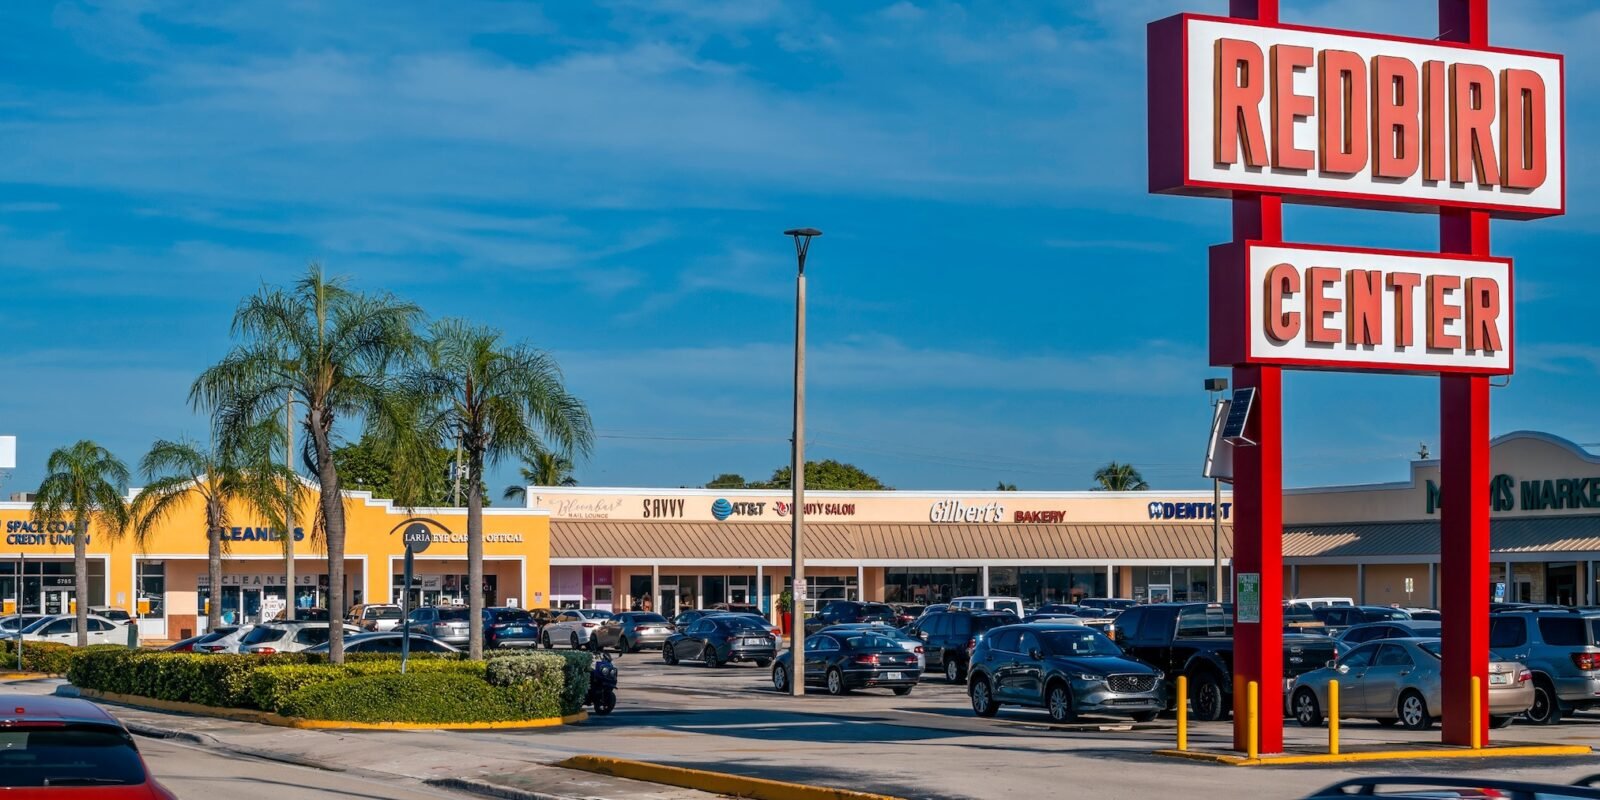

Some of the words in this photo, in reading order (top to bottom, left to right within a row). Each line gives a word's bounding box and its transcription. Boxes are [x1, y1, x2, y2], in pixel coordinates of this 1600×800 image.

[1213, 37, 1548, 190] REDBIRD
[1264, 262, 1504, 353] CENTER
[643, 498, 685, 518] SAVVY
[730, 501, 767, 516] AT&T
[825, 503, 856, 516] SALON
[929, 498, 1005, 523] Gilbert's
[1013, 510, 1067, 523] BAKERY
[7, 520, 45, 533] SPACE
[47, 520, 89, 533] COAT
[6, 533, 46, 545] CREDIT
[206, 526, 305, 542] LEANES
[432, 534, 449, 543] EYE
[450, 534, 470, 543] CAR
[486, 534, 524, 543] OPTICAL
[221, 575, 311, 585] CLEANES
